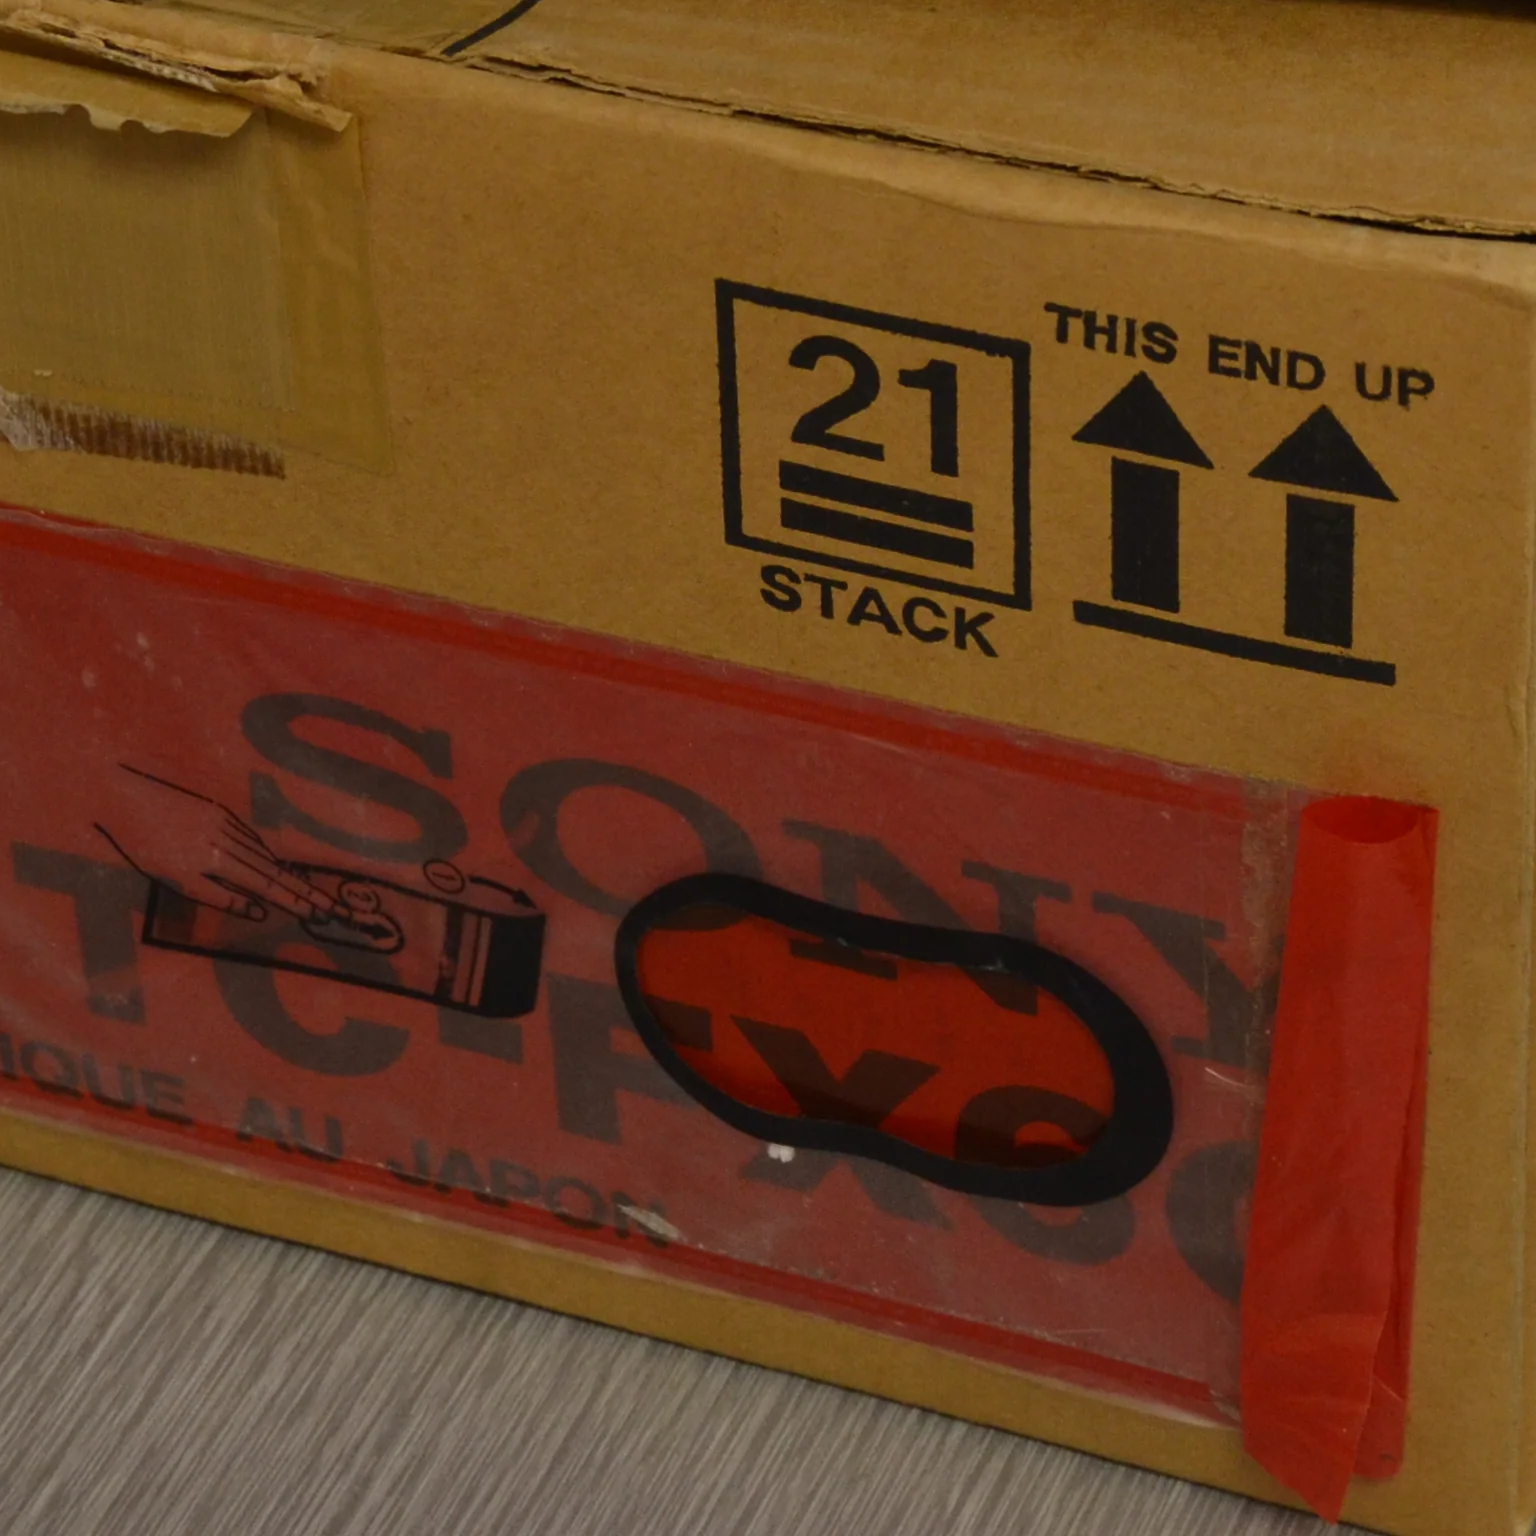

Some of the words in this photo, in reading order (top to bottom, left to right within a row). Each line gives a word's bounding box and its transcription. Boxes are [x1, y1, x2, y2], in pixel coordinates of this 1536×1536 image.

[787, 334, 959, 478] 21
[1044, 302, 1180, 364] THIS
[1207, 334, 1326, 392] END
[1355, 361, 1436, 408] UP
[760, 564, 999, 658] STACK
[240, 690, 1270, 1070] SONY
[237, 1096, 345, 1162] AU
[385, 1138, 671, 1249] JAPON
